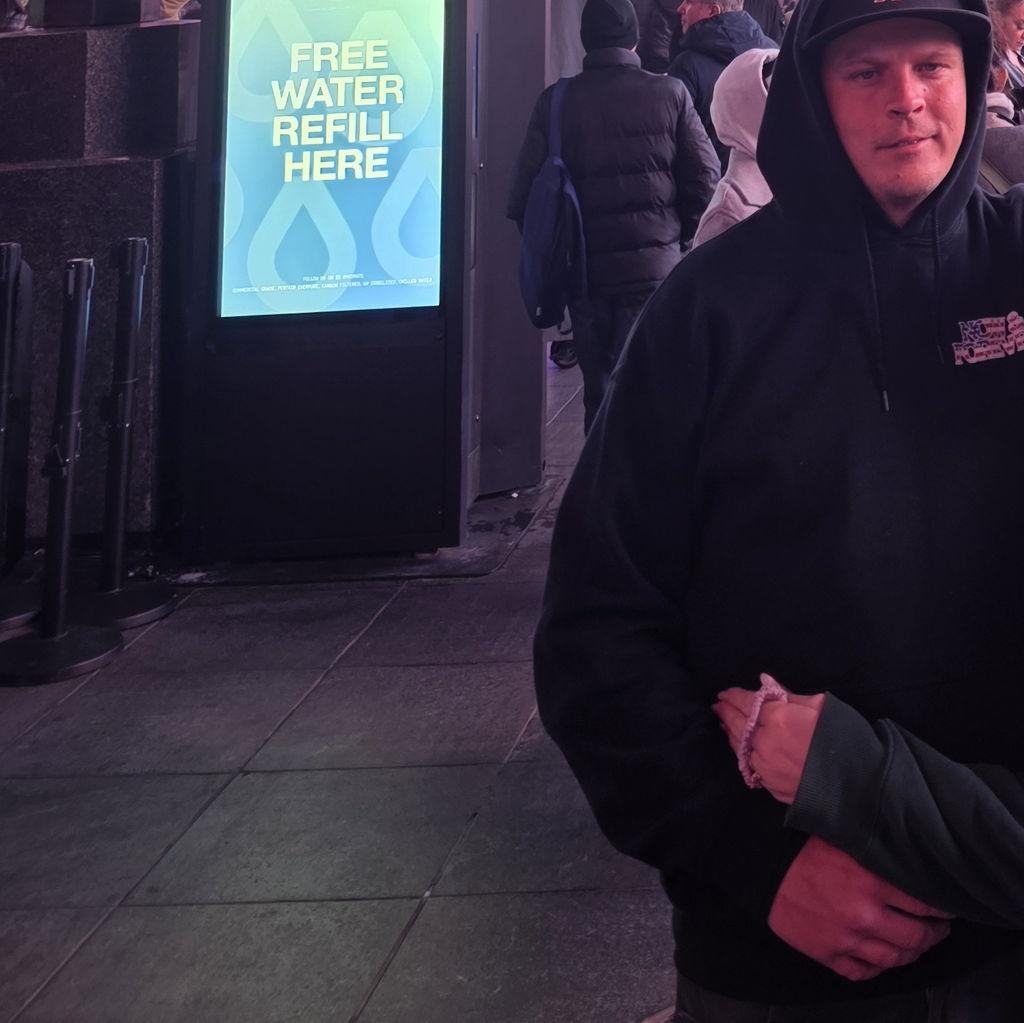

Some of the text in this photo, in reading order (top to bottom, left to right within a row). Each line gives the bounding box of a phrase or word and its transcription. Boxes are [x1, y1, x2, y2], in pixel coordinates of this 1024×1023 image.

[290, 40, 389, 73] FREE
[271, 75, 405, 110] WATER
[272, 110, 404, 147] REFILL
[284, 146, 390, 183] HERE
